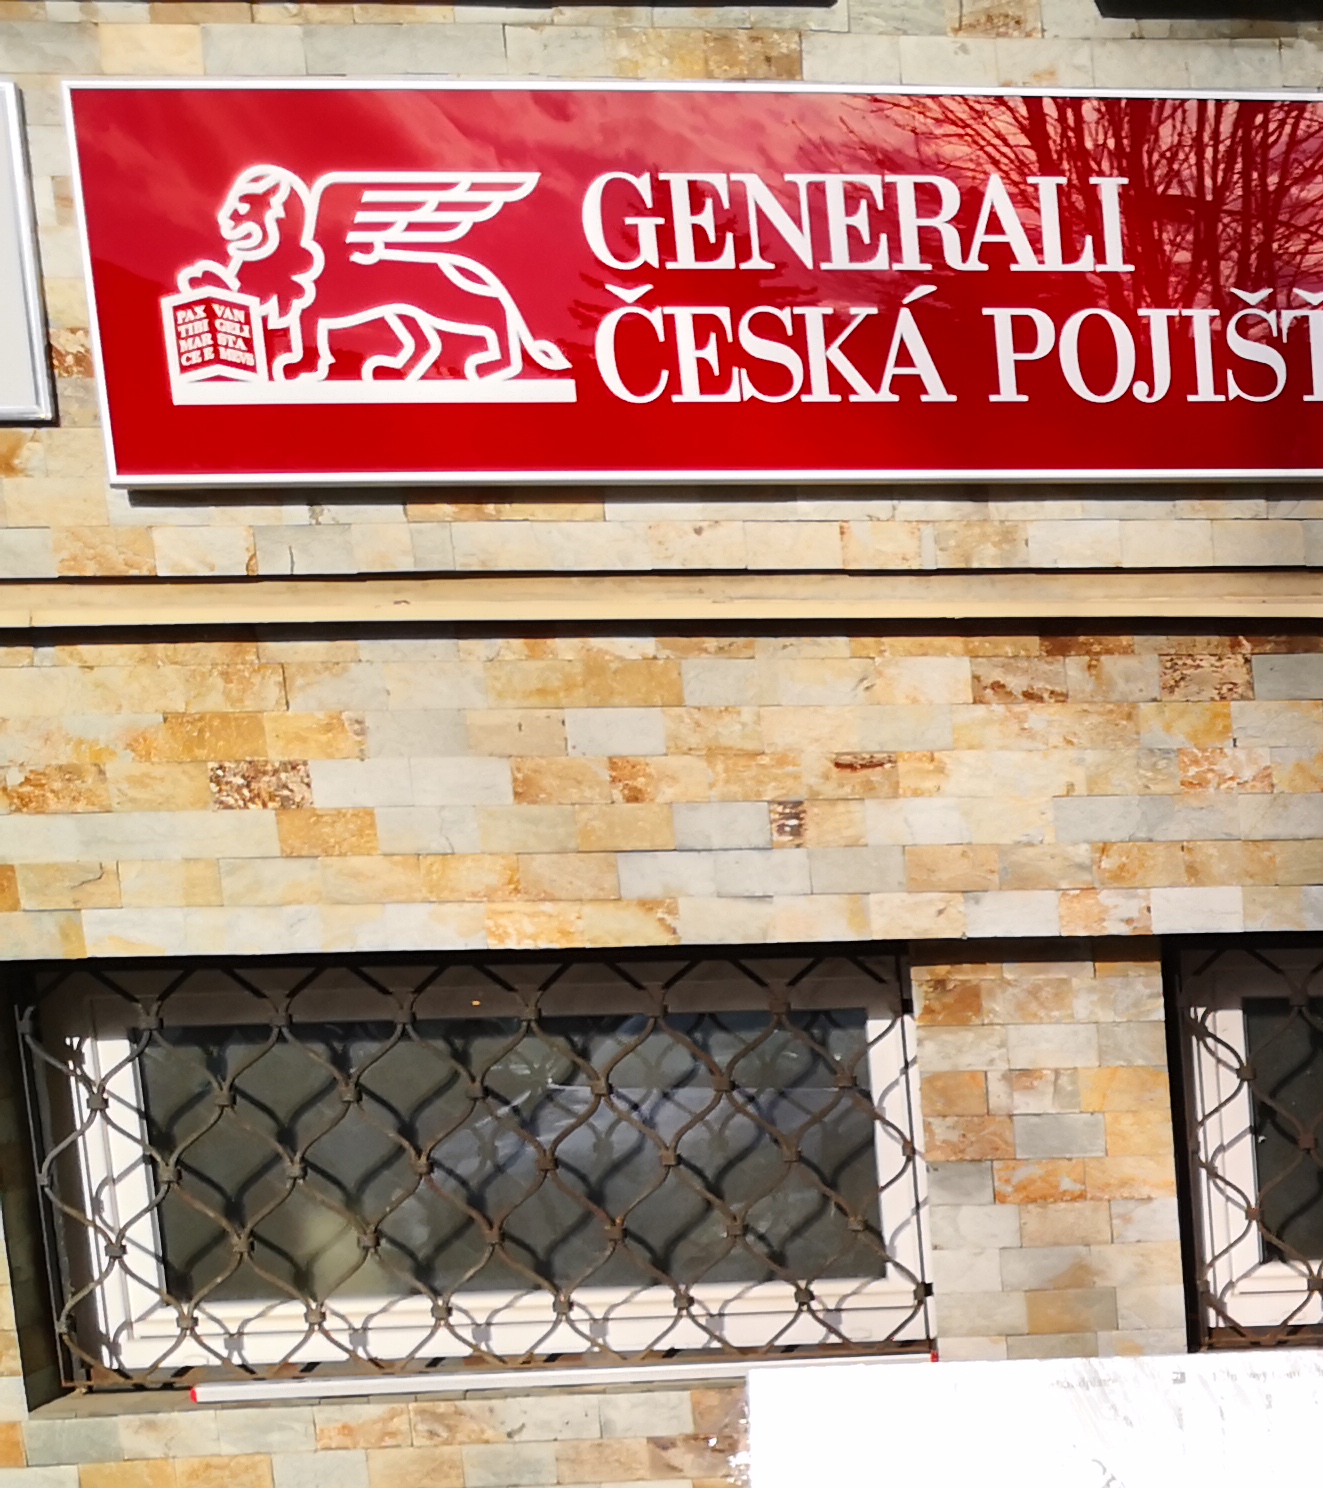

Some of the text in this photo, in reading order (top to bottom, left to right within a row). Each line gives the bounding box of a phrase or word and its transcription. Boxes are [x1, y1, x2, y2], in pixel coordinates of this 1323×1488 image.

[582, 171, 1135, 271] GENERALI
[176, 304, 208, 325] PAX
[211, 303, 245, 324] VAN
[595, 284, 958, 404] ČESKÁ
